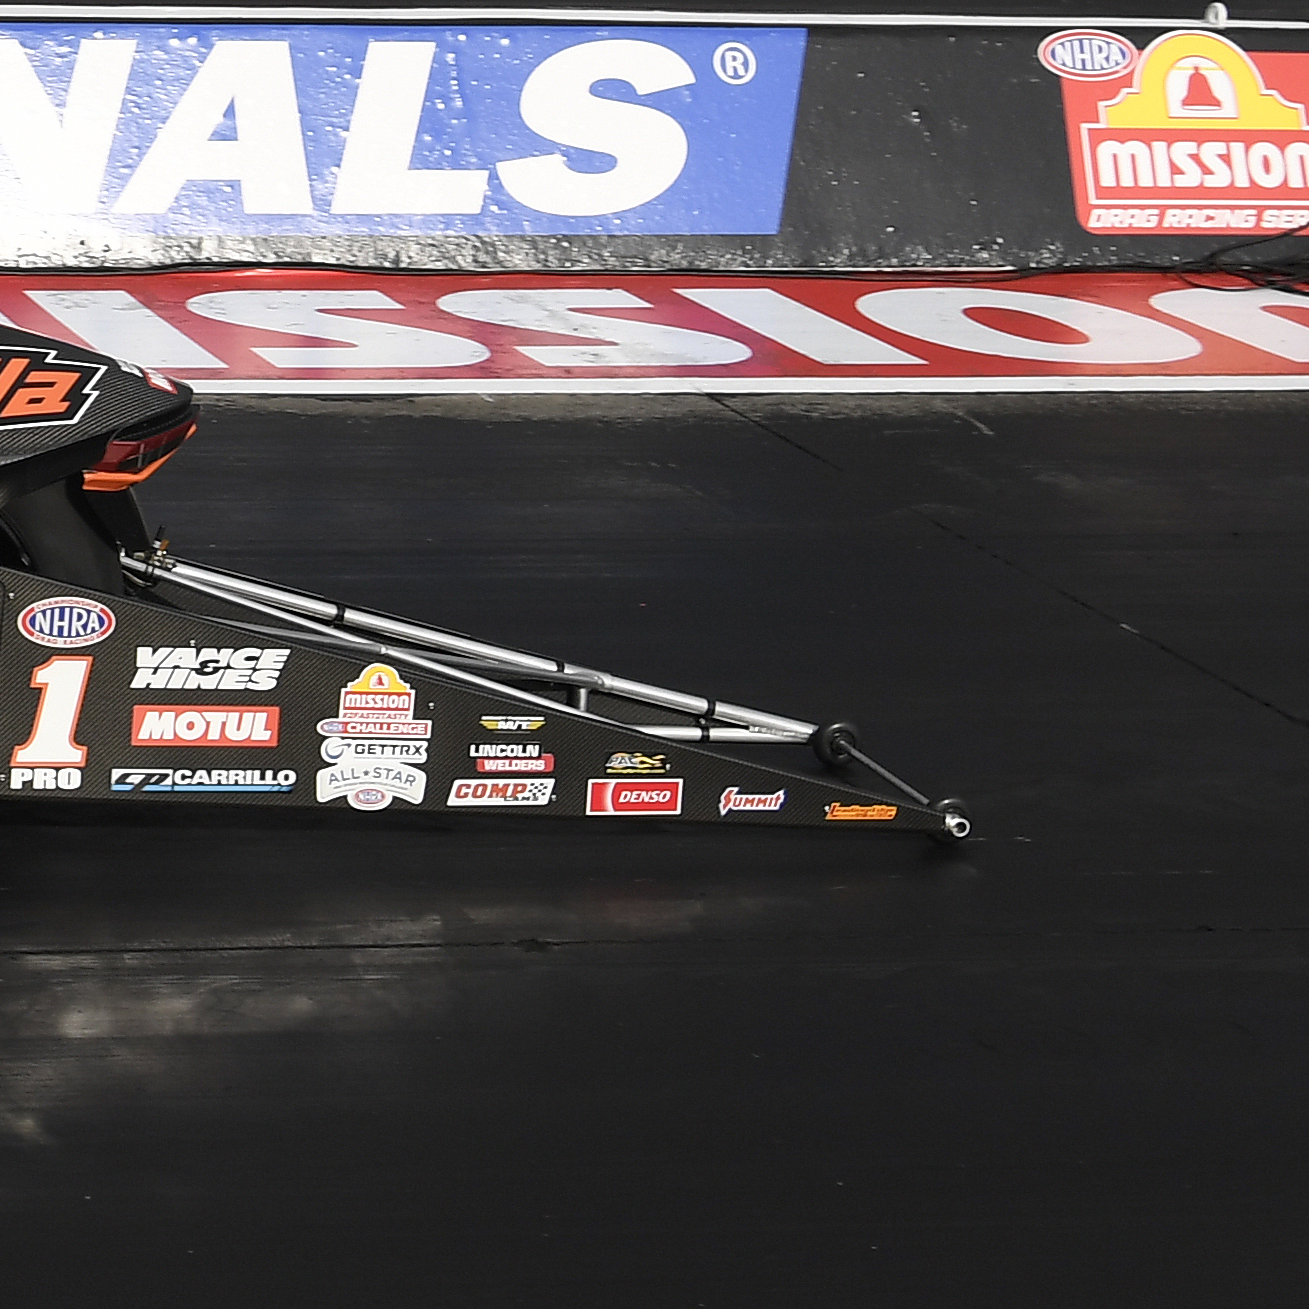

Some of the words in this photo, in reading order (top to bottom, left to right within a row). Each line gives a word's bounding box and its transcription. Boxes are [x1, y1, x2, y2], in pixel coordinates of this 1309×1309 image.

[1053, 39, 1126, 70] NHRA
[1088, 208, 1160, 228] DRAG
[1162, 209, 1258, 228] RACING
[1260, 209, 1309, 229] SER
[35, 607, 100, 637] NHRA
[134, 646, 291, 670] VANCE
[130, 668, 280, 691] HINES
[10, 655, 94, 767] 1
[344, 693, 410, 709] MISSION
[137, 711, 274, 741] MOTUL
[346, 722, 427, 734] CHALLENGE
[354, 743, 424, 756] GETTRX
[469, 744, 540, 758] LINCOLN
[484, 759, 546, 771] WELDERS
[9, 768, 82, 790] PRO
[174, 769, 297, 786] CARRILLO
[328, 768, 361, 786] ALL
[372, 766, 417, 787] STAR
[454, 783, 528, 799] COMP
[618, 790, 671, 803] DENSO
